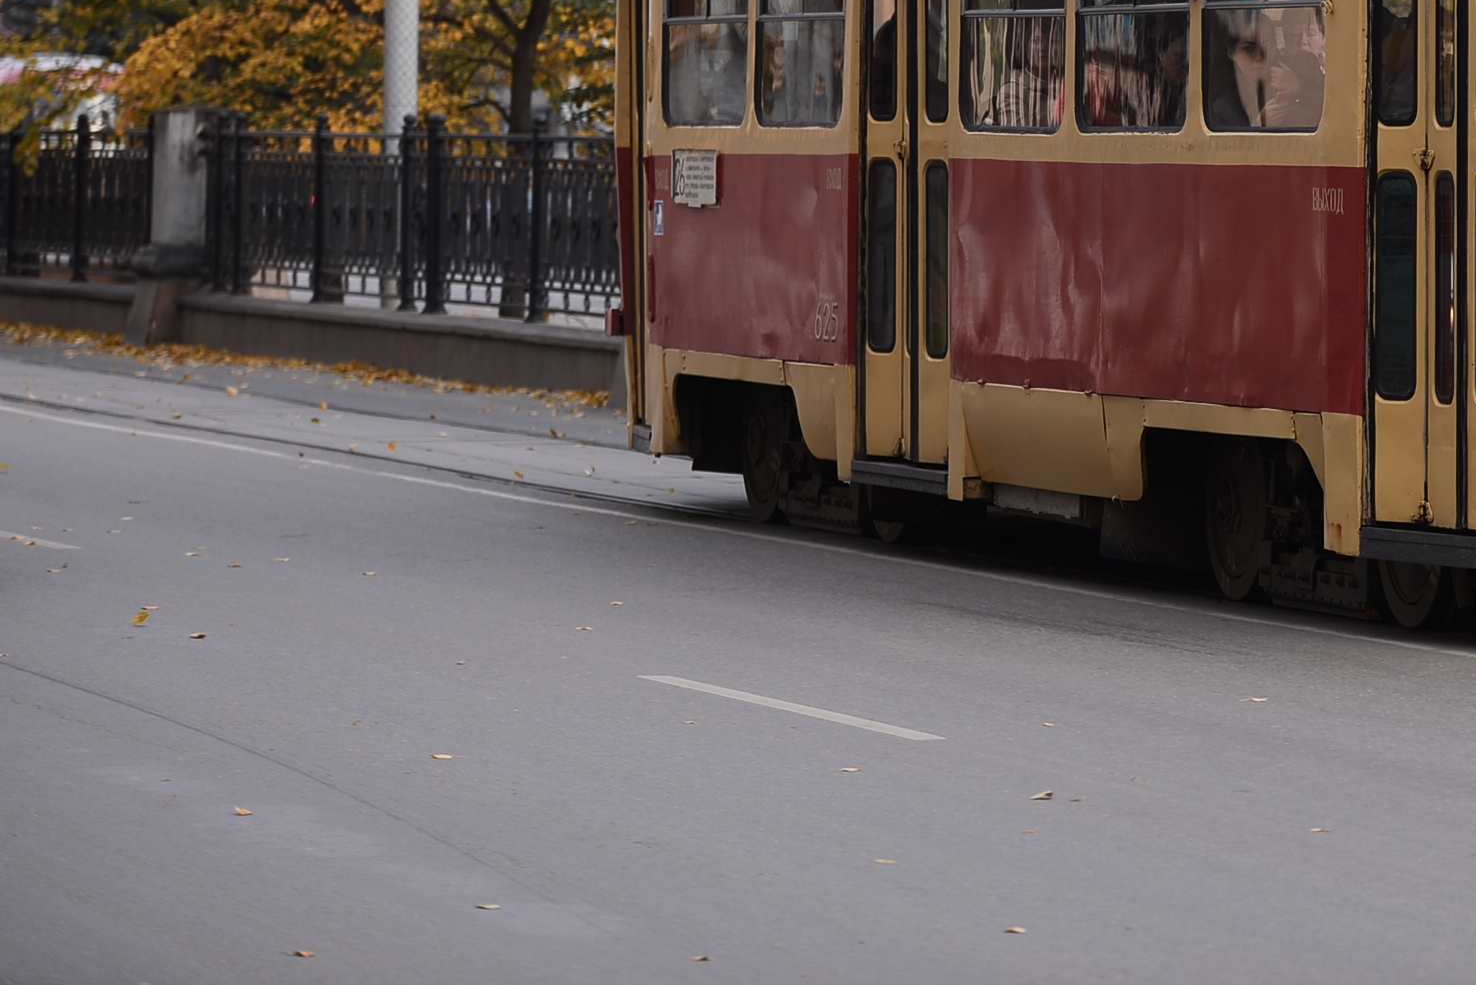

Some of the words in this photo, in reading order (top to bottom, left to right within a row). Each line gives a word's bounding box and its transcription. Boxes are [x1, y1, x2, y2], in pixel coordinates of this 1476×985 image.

[674, 158, 685, 196] 26
[826, 168, 842, 190] ВХОД
[1312, 187, 1344, 215] ВЫХОД
[815, 302, 839, 343] 625
